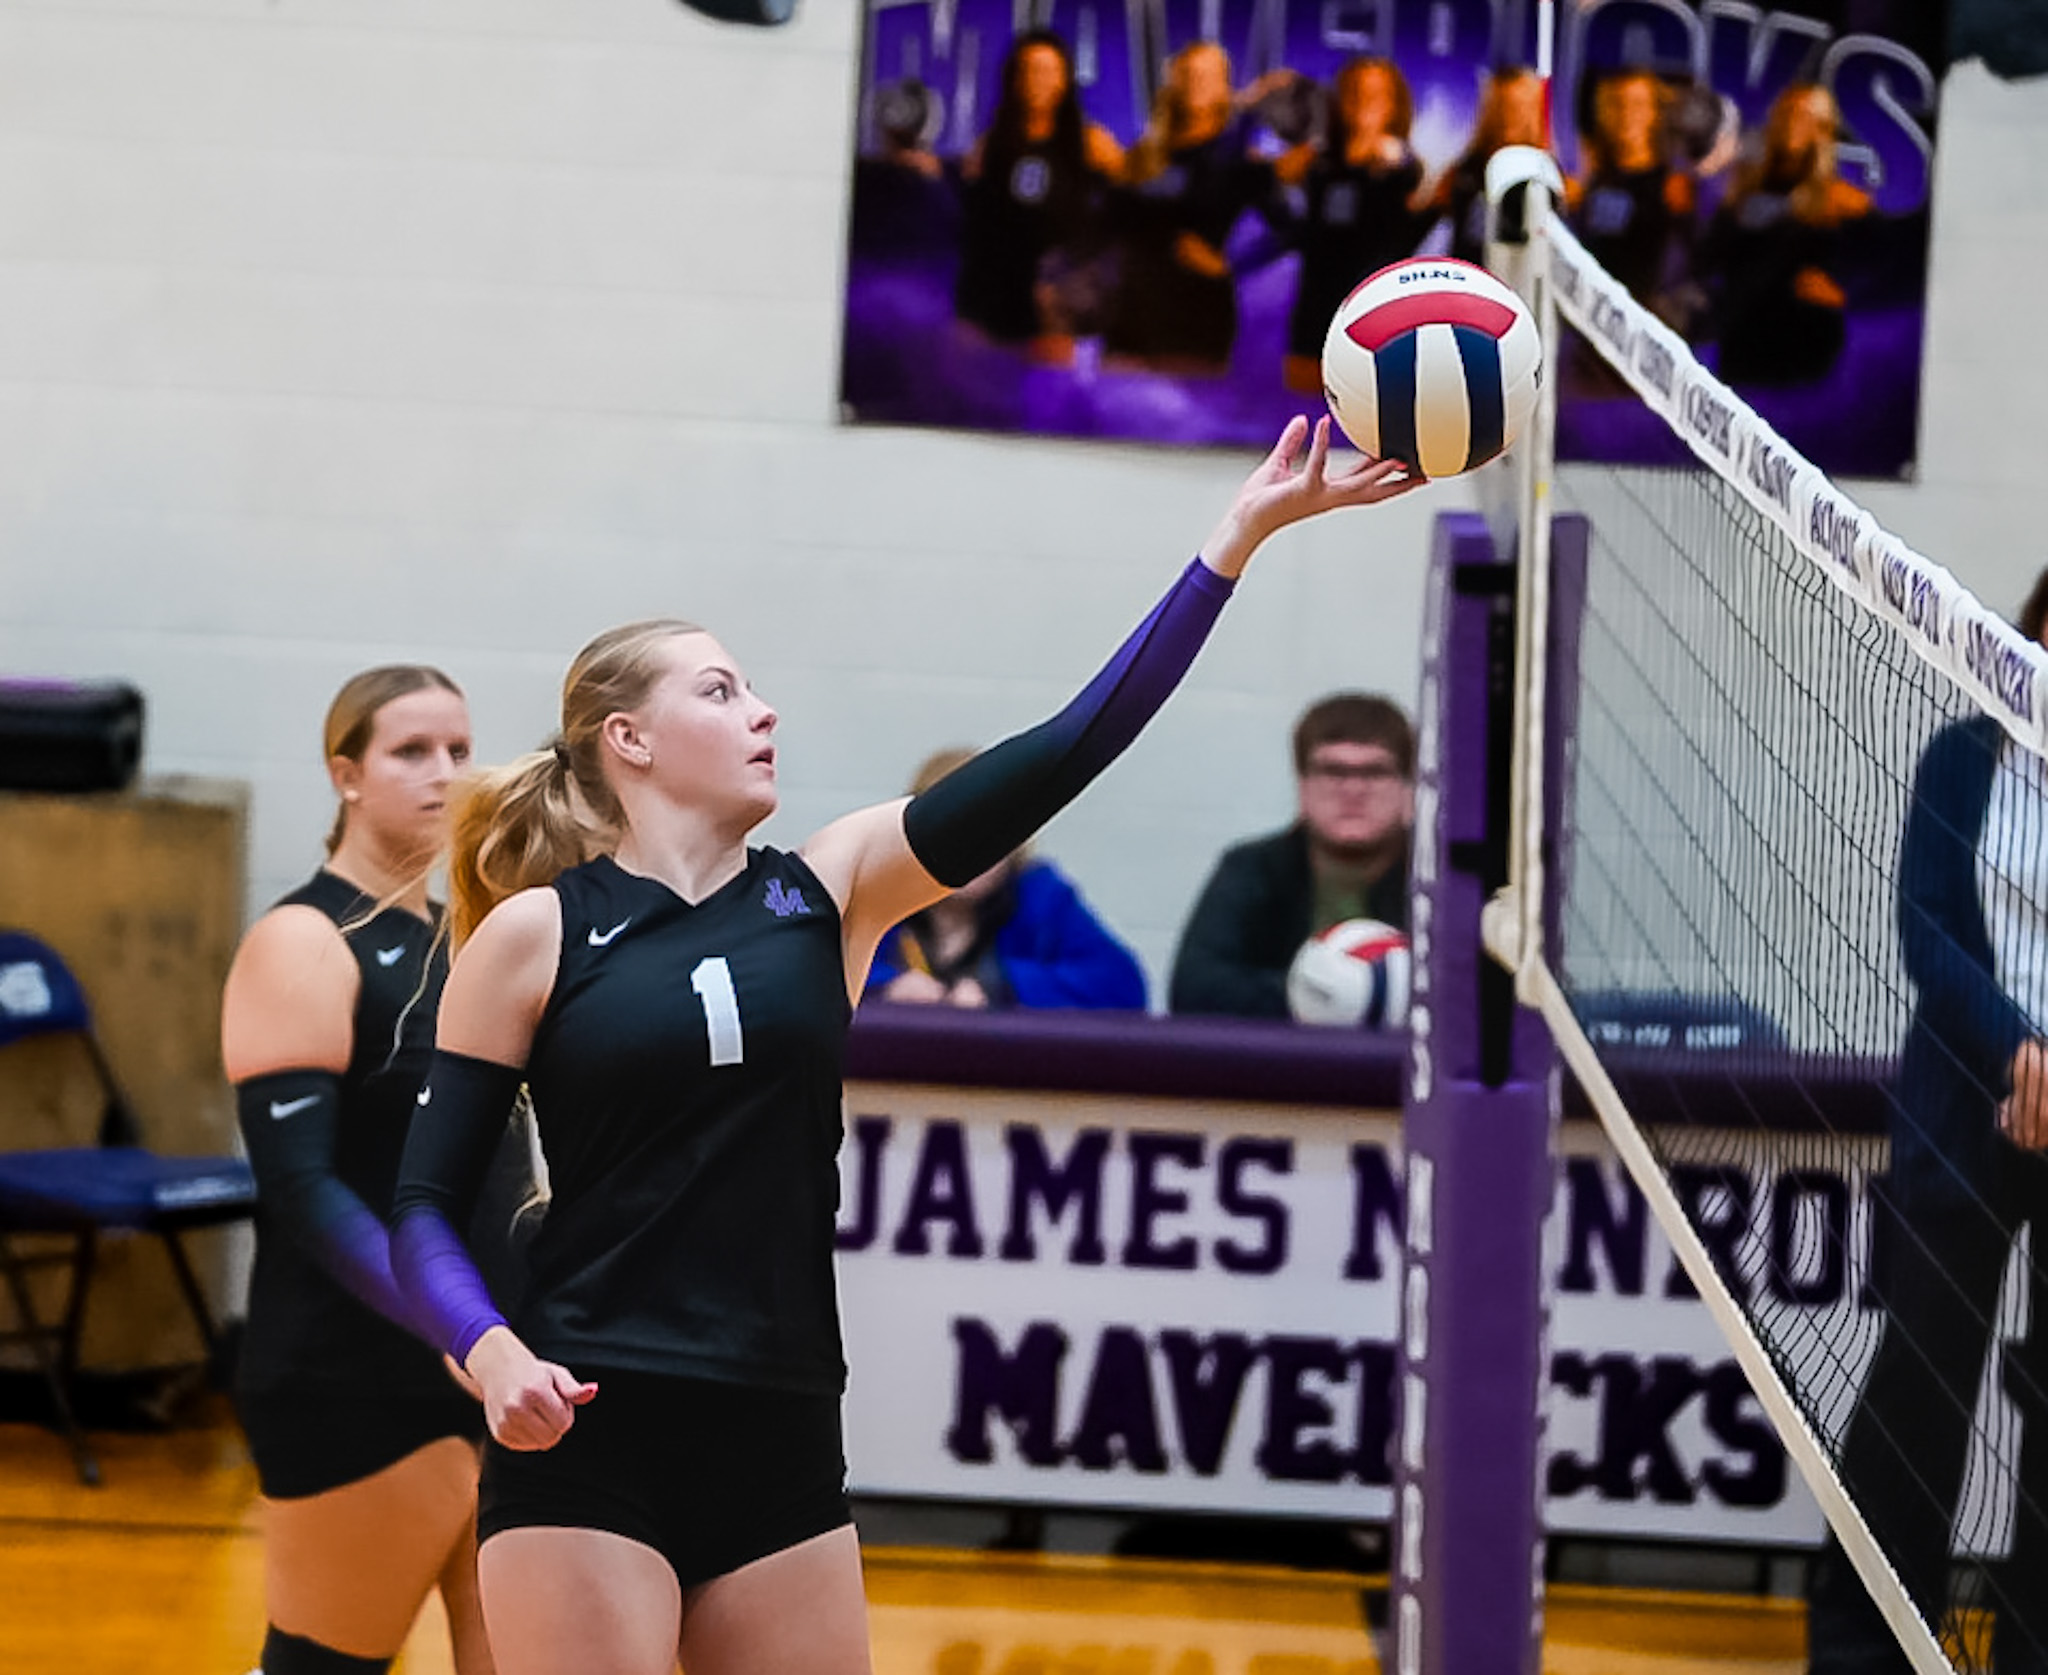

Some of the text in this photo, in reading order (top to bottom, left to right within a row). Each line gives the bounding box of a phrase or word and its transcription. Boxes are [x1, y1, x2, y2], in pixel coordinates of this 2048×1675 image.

[690, 956, 744, 1066] 1
[834, 1115, 1886, 1308] JAMES MNRO
[947, 1315, 1790, 1512] MAVECKS
